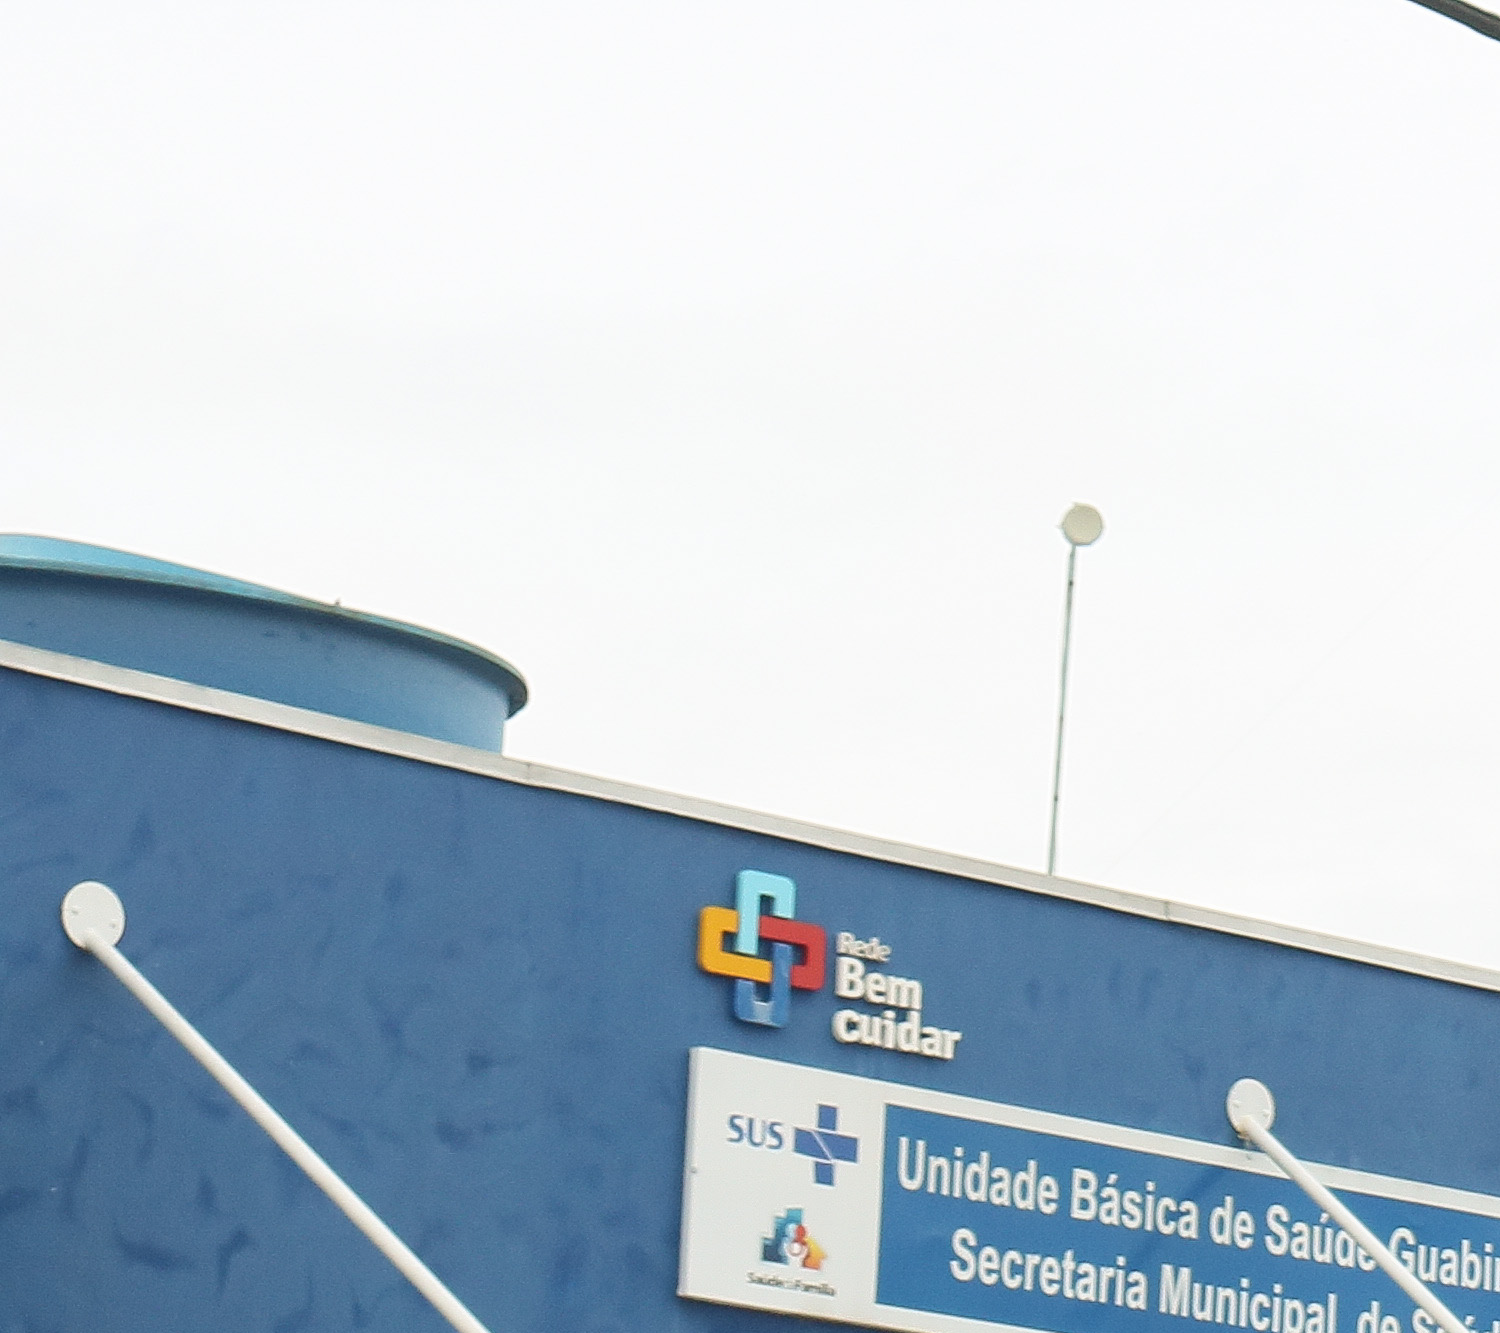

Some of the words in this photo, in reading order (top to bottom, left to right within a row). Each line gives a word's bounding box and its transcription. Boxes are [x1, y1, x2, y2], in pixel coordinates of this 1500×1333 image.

[837, 932, 890, 962] Rede
[834, 956, 923, 1010] Bem
[831, 1008, 962, 1060] cuidar
[726, 1113, 784, 1151] SUS
[898, 1136, 1060, 1215] Unidade
[1070, 1167, 1200, 1240] Básica
[1209, 1195, 1256, 1250] de
[1264, 1204, 1377, 1272] Saúde
[950, 1228, 1148, 1311] Secretaria
